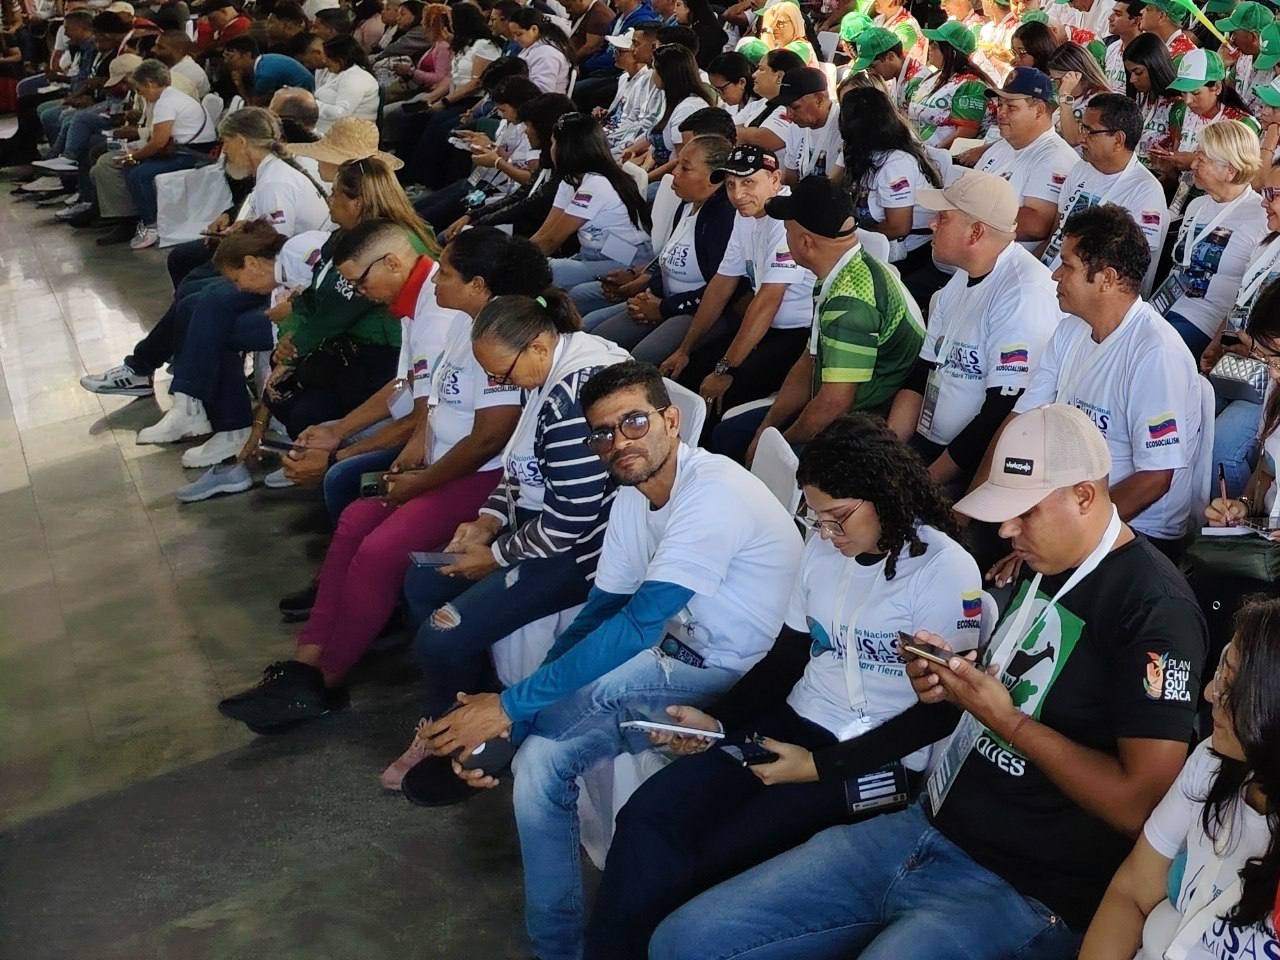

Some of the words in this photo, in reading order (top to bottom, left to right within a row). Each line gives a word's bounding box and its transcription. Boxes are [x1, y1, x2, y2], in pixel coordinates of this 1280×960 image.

[877, 664, 904, 677] Tierra
[1168, 658, 1191, 671] PLAN
[1166, 669, 1190, 682] CHU
[1165, 680, 1187, 692] QUI
[1164, 690, 1191, 702] SACA
[975, 736, 1026, 778] QUES
